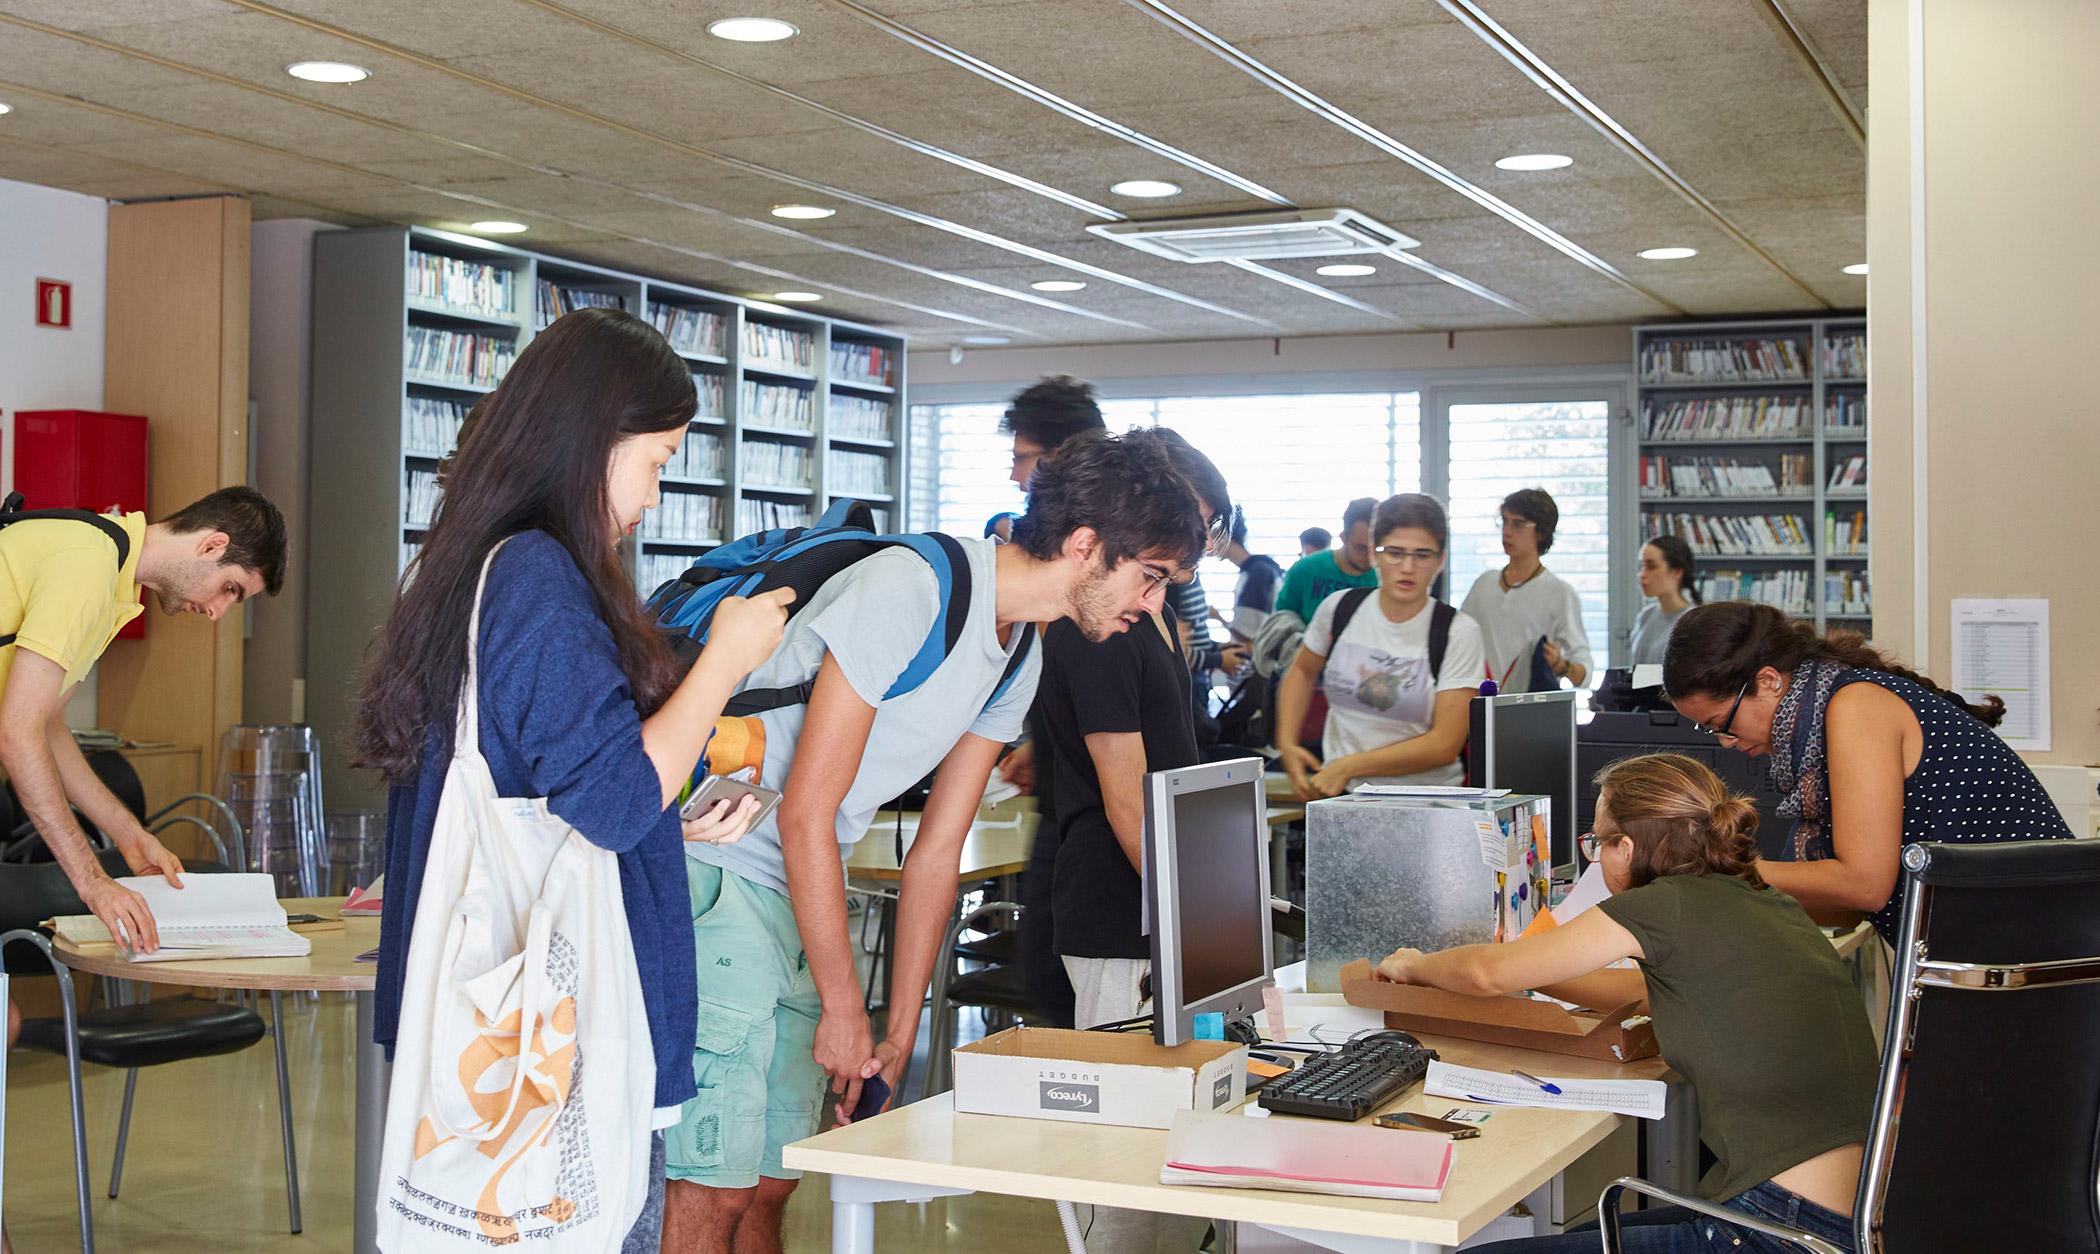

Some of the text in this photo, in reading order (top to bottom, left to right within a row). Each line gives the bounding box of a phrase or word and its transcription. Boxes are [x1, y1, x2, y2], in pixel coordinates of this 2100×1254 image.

[716, 956, 732, 967] AS
[1039, 1071, 1100, 1082] BUDGET
[1050, 1090, 1088, 1104] Lyreco
